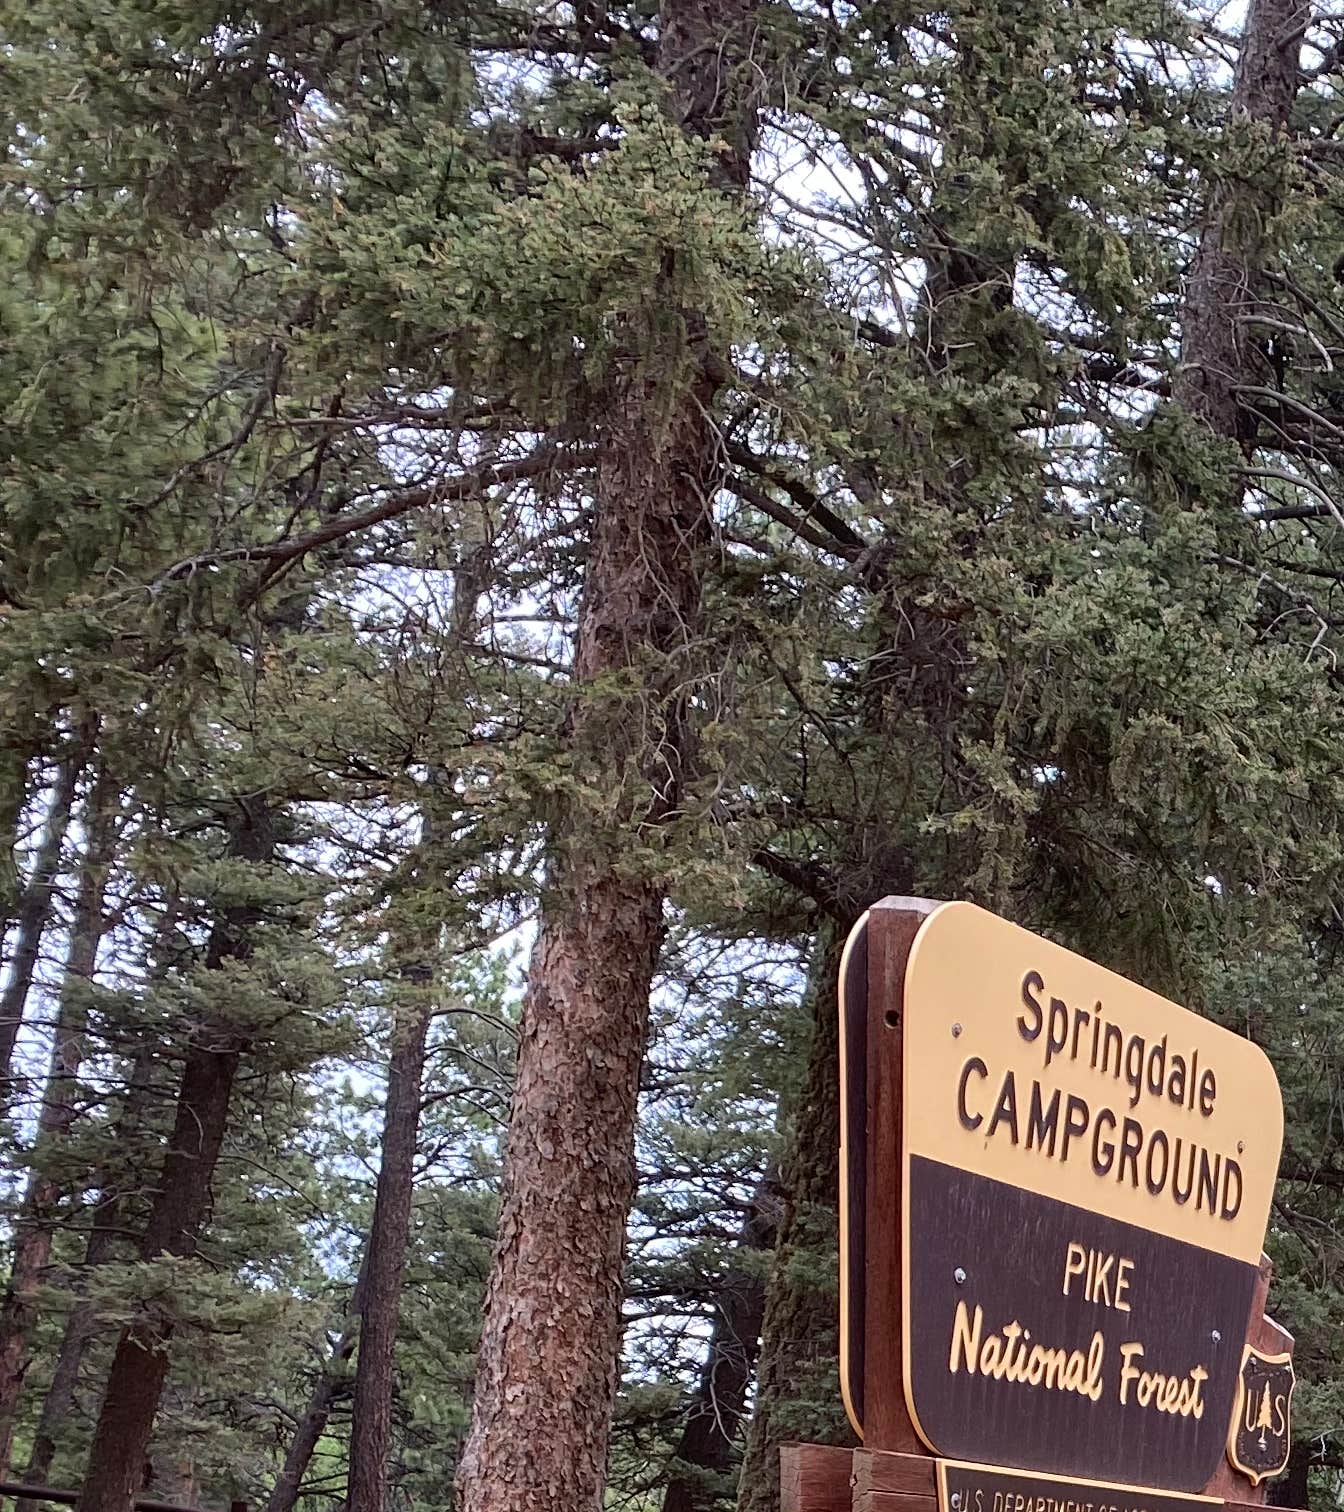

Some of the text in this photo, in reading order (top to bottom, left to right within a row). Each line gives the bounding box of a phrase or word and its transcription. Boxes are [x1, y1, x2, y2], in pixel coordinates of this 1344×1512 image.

[1017, 969, 1217, 1118] Springdale
[956, 1056, 1244, 1221] CAMPGROUND
[1062, 1241, 1136, 1312] PIKE
[948, 1299, 1209, 1420] National Forest
